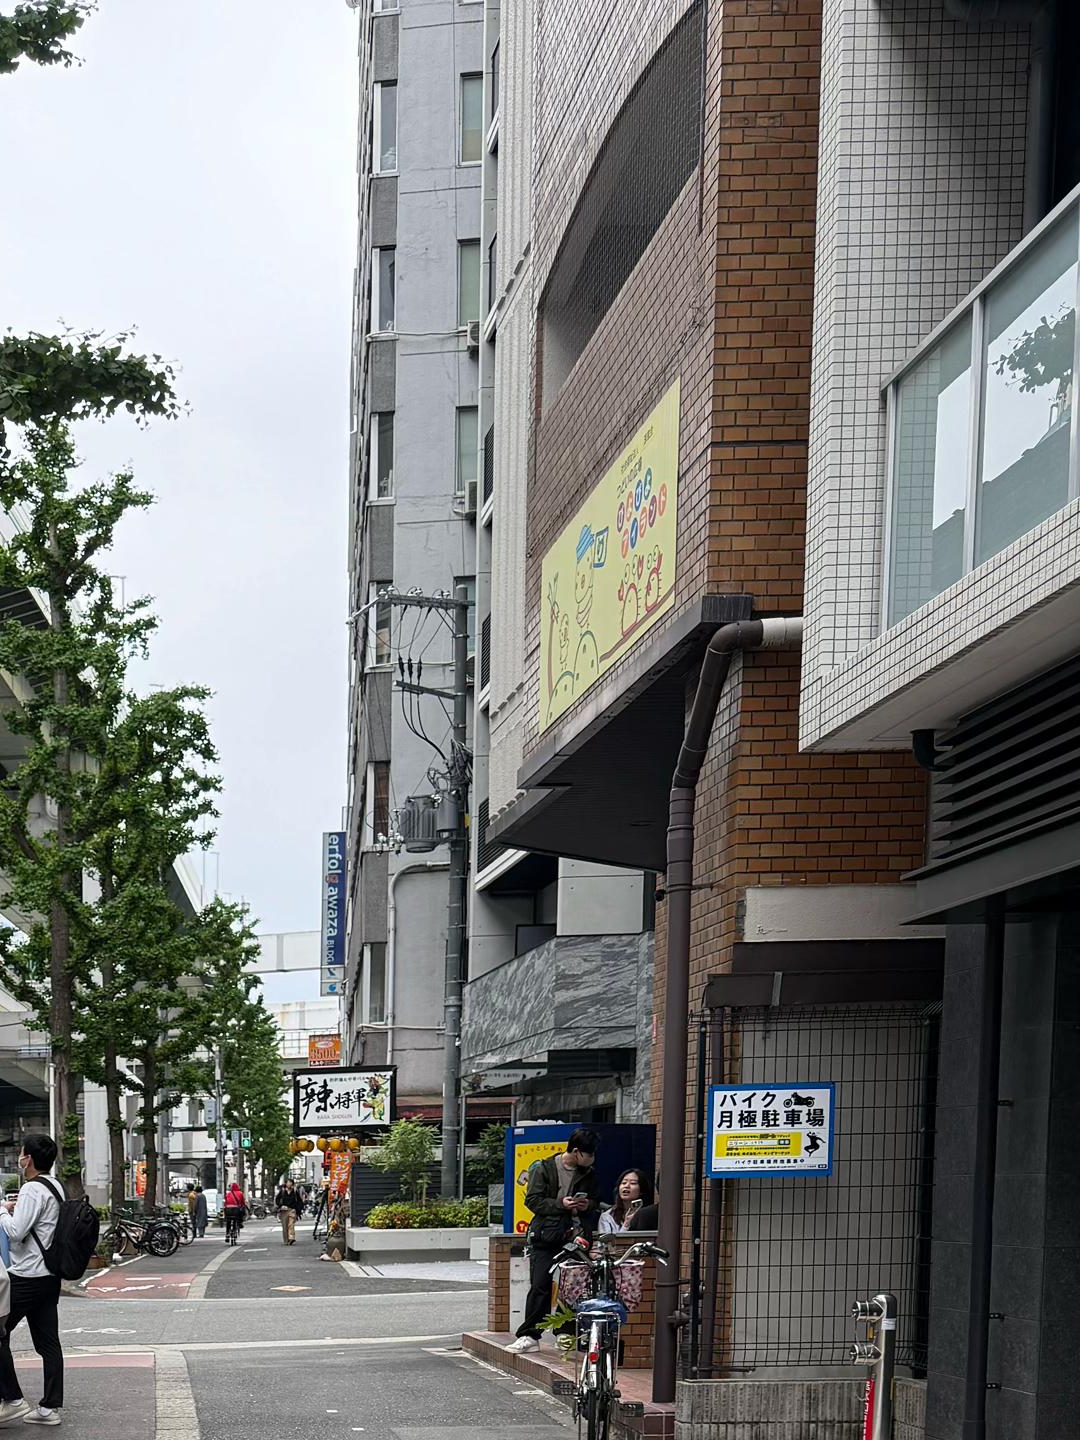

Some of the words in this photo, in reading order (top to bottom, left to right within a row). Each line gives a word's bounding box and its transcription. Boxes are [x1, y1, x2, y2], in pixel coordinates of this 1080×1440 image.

[621, 483, 667, 558] アイランド
[325, 834, 342, 884] erfolg
[327, 886, 338, 936] awaza
[300, 1077, 368, 1120] 辣将軍
[717, 1108, 825, 1129] 月極駐車場
[719, 1091, 777, 1109] バイク
